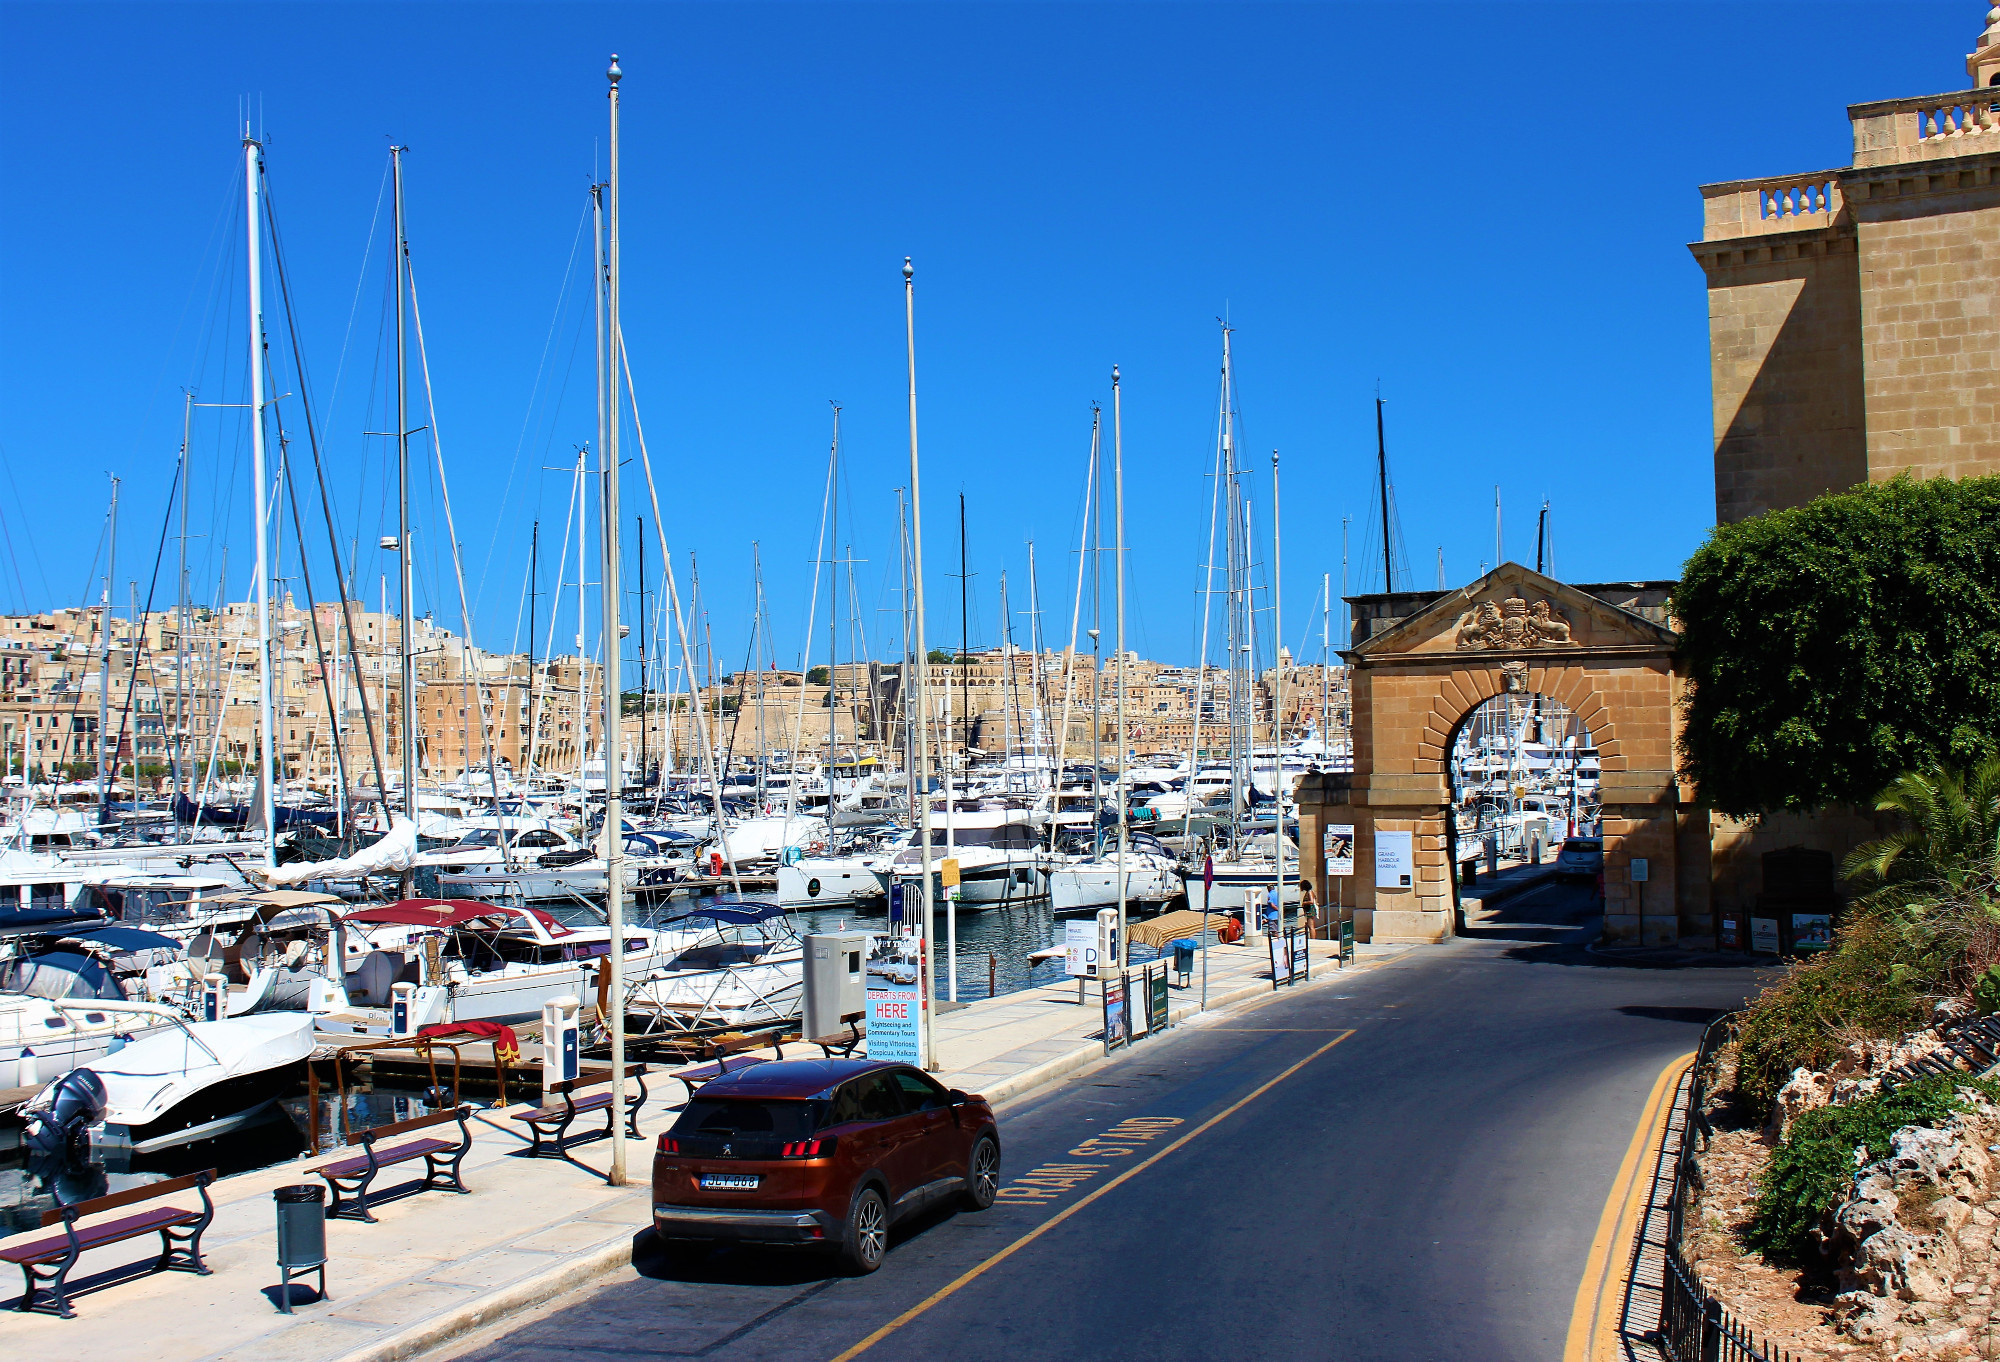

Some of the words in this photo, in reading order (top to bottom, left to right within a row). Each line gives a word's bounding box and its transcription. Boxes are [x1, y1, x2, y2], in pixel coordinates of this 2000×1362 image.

[1086, 948, 1097, 962] D
[868, 992, 896, 1000] DEPARTS
[898, 992, 916, 1000] FROM
[876, 1003, 908, 1018] HERE
[868, 1040, 888, 1048] Visiting
[868, 1049, 895, 1057] Cospicua,
[1068, 1117, 1185, 1157] STAND
[708, 1176, 730, 1186] JLY
[734, 1176, 756, 1187] 068
